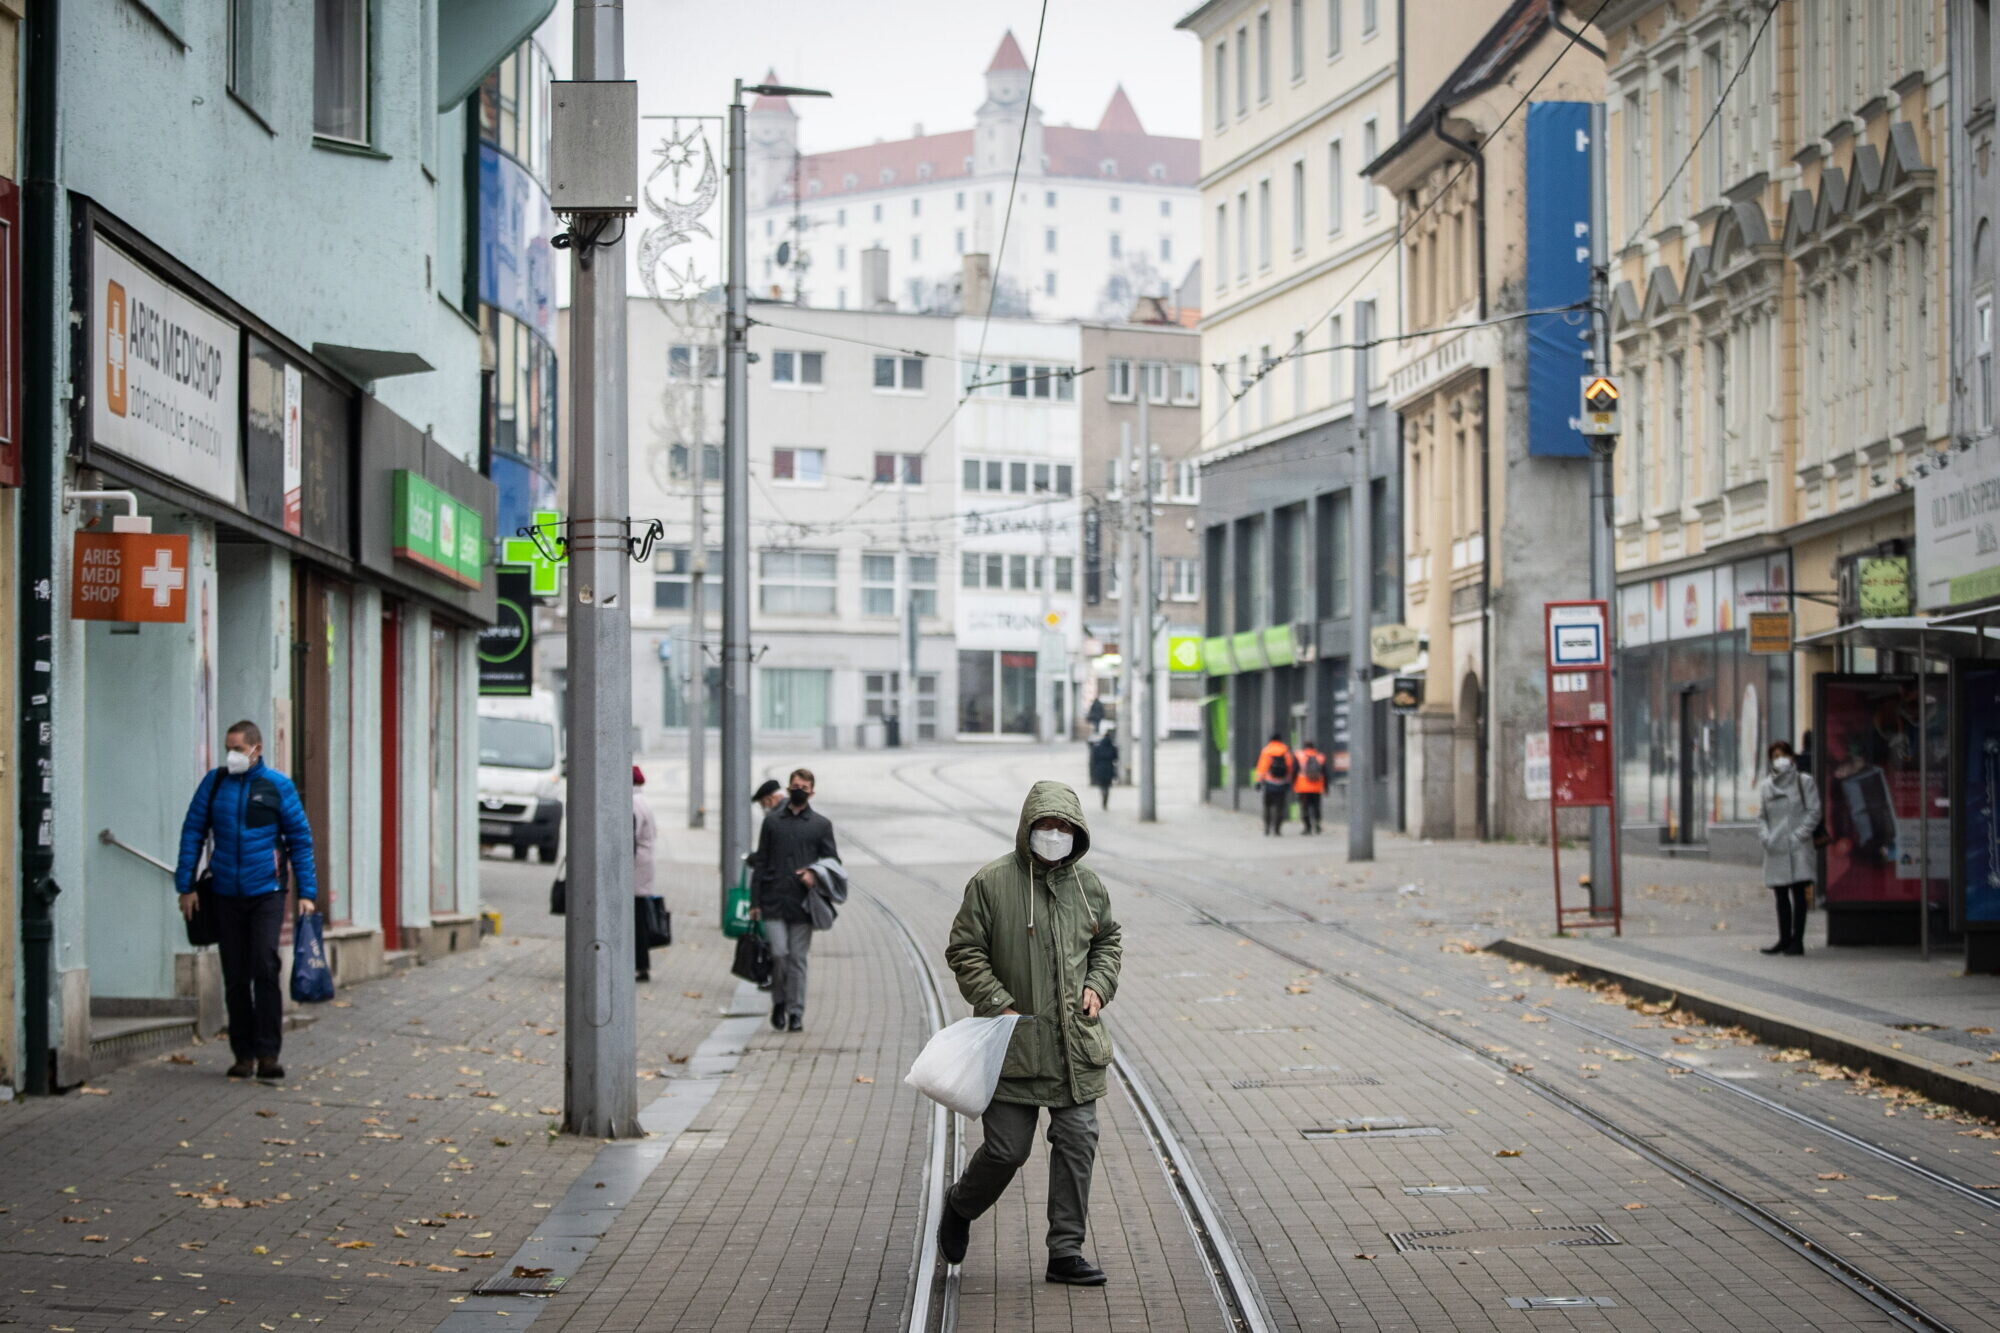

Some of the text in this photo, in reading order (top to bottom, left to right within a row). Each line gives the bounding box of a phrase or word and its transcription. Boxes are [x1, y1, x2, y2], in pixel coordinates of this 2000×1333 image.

[130, 297, 222, 402] ARIES MEDISHOP
[82, 548, 121, 566] ARIES
[81, 567, 121, 585] MEDI
[81, 585, 120, 603] SHOP
